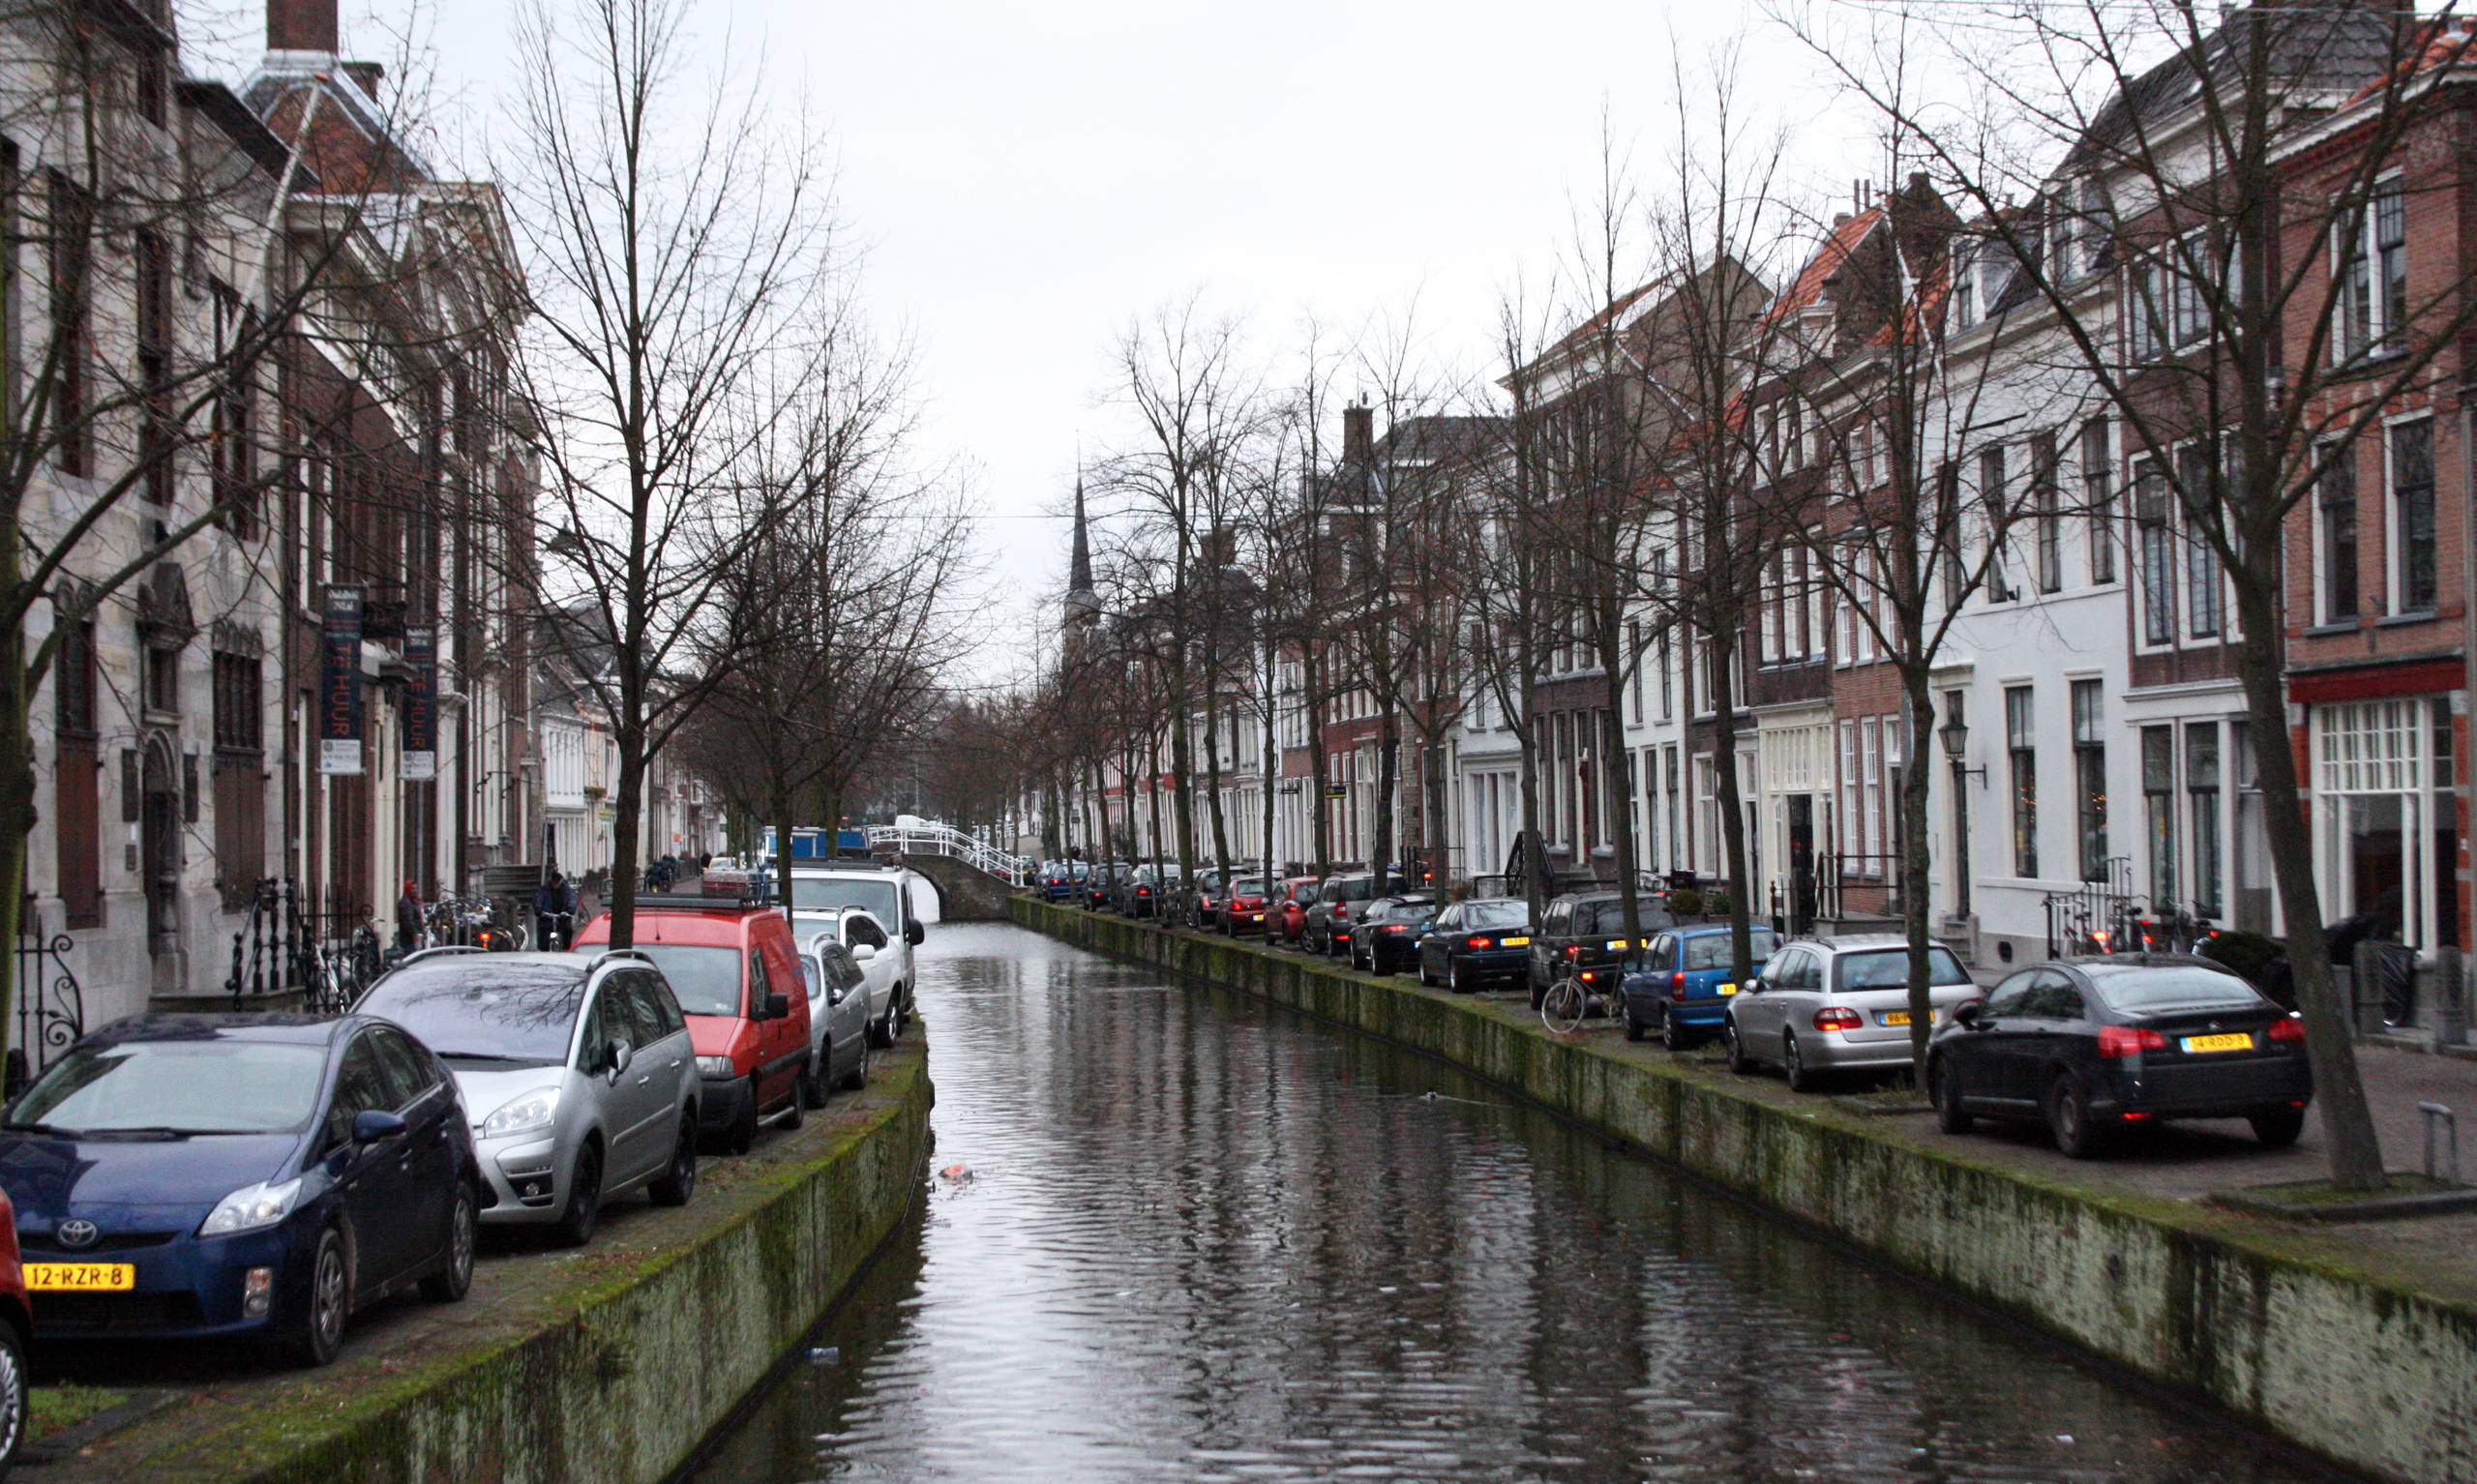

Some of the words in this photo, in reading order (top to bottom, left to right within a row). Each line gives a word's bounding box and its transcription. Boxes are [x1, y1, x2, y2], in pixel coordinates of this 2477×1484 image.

[332, 642, 352, 668] TE
[410, 671, 426, 692] TE
[331, 674, 350, 735] HUUR
[409, 698, 426, 748] HUUR
[32, 1267, 123, 1286] 12-RZR-8
